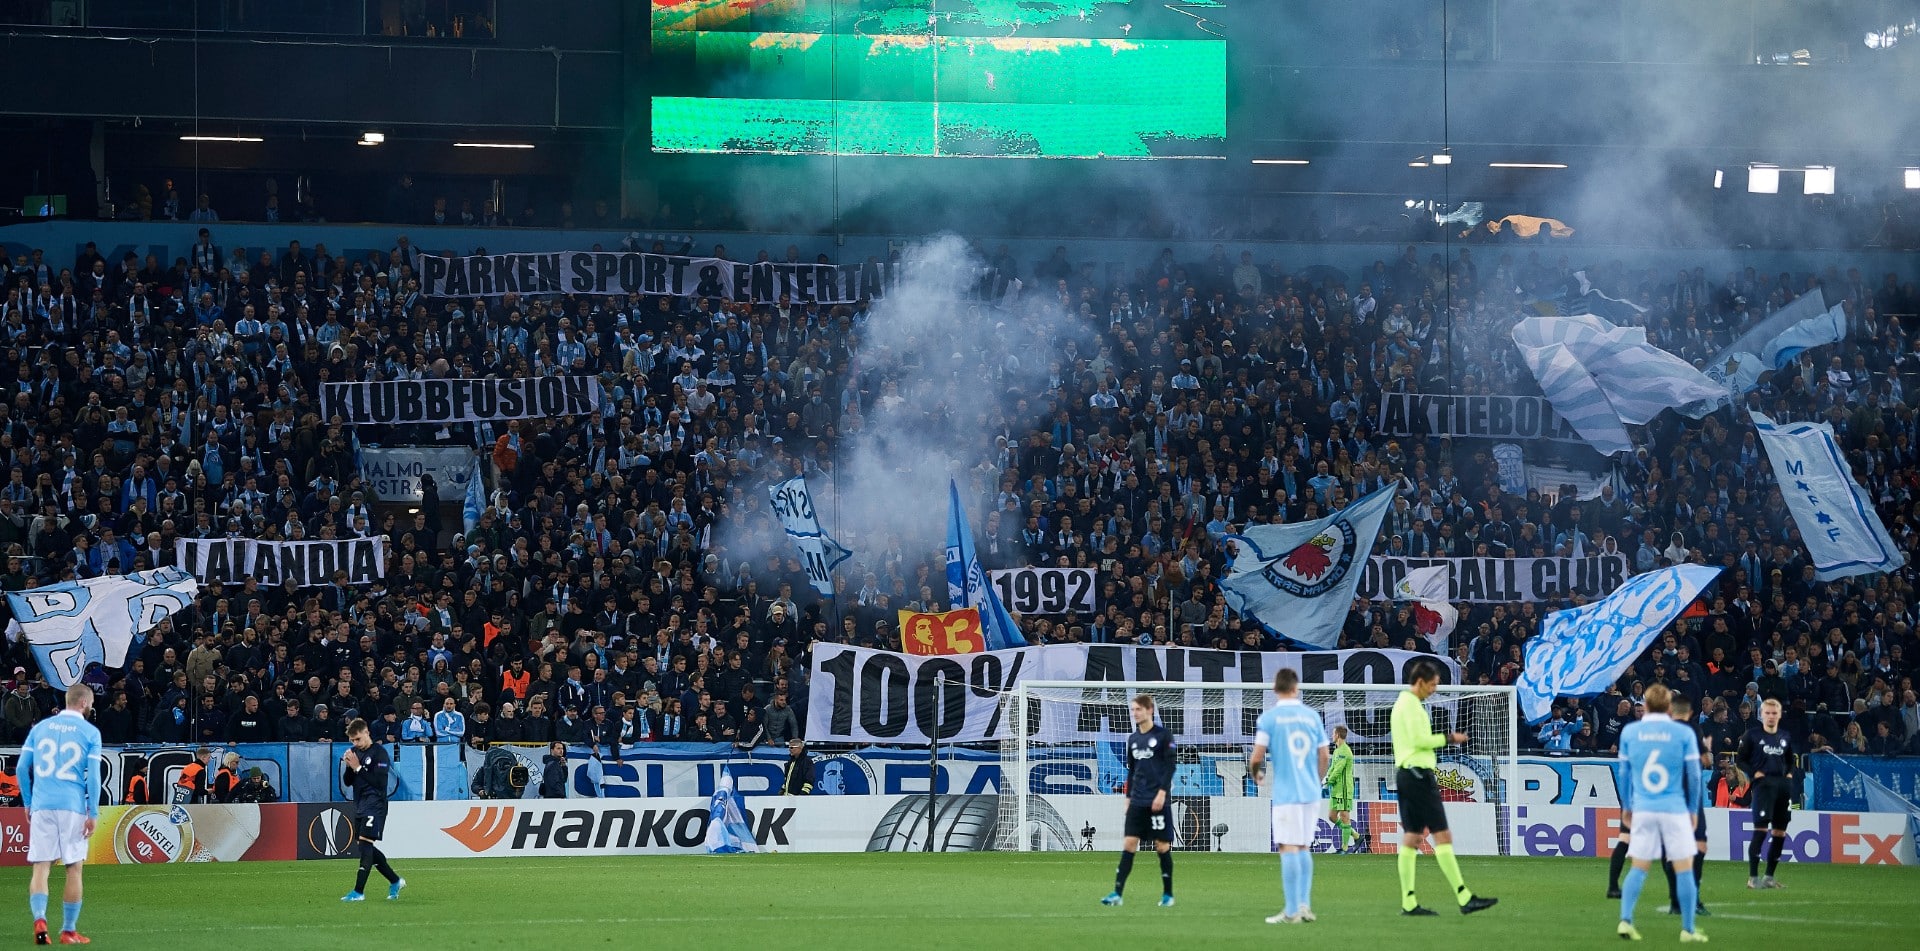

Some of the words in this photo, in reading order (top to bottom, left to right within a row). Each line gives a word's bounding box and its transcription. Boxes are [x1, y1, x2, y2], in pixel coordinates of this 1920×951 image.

[423, 253, 561, 297] PARKEN
[571, 252, 691, 296] SPORT
[696, 264, 723, 298] &
[325, 375, 593, 423] KLUBBFUSION
[185, 541, 376, 585] LALANDIA
[1531, 556, 1625, 600] CLUB
[995, 570, 1091, 614] 1992
[820, 649, 1042, 740] 100%
[1076, 646, 1264, 736] ANTI
[35, 737, 82, 782] 32
[1287, 730, 1311, 769] 9
[1641, 748, 1670, 795] 6
[140, 820, 175, 855] AMSTEL
[365, 815, 375, 828] 2
[511, 808, 797, 850] HANKOK
